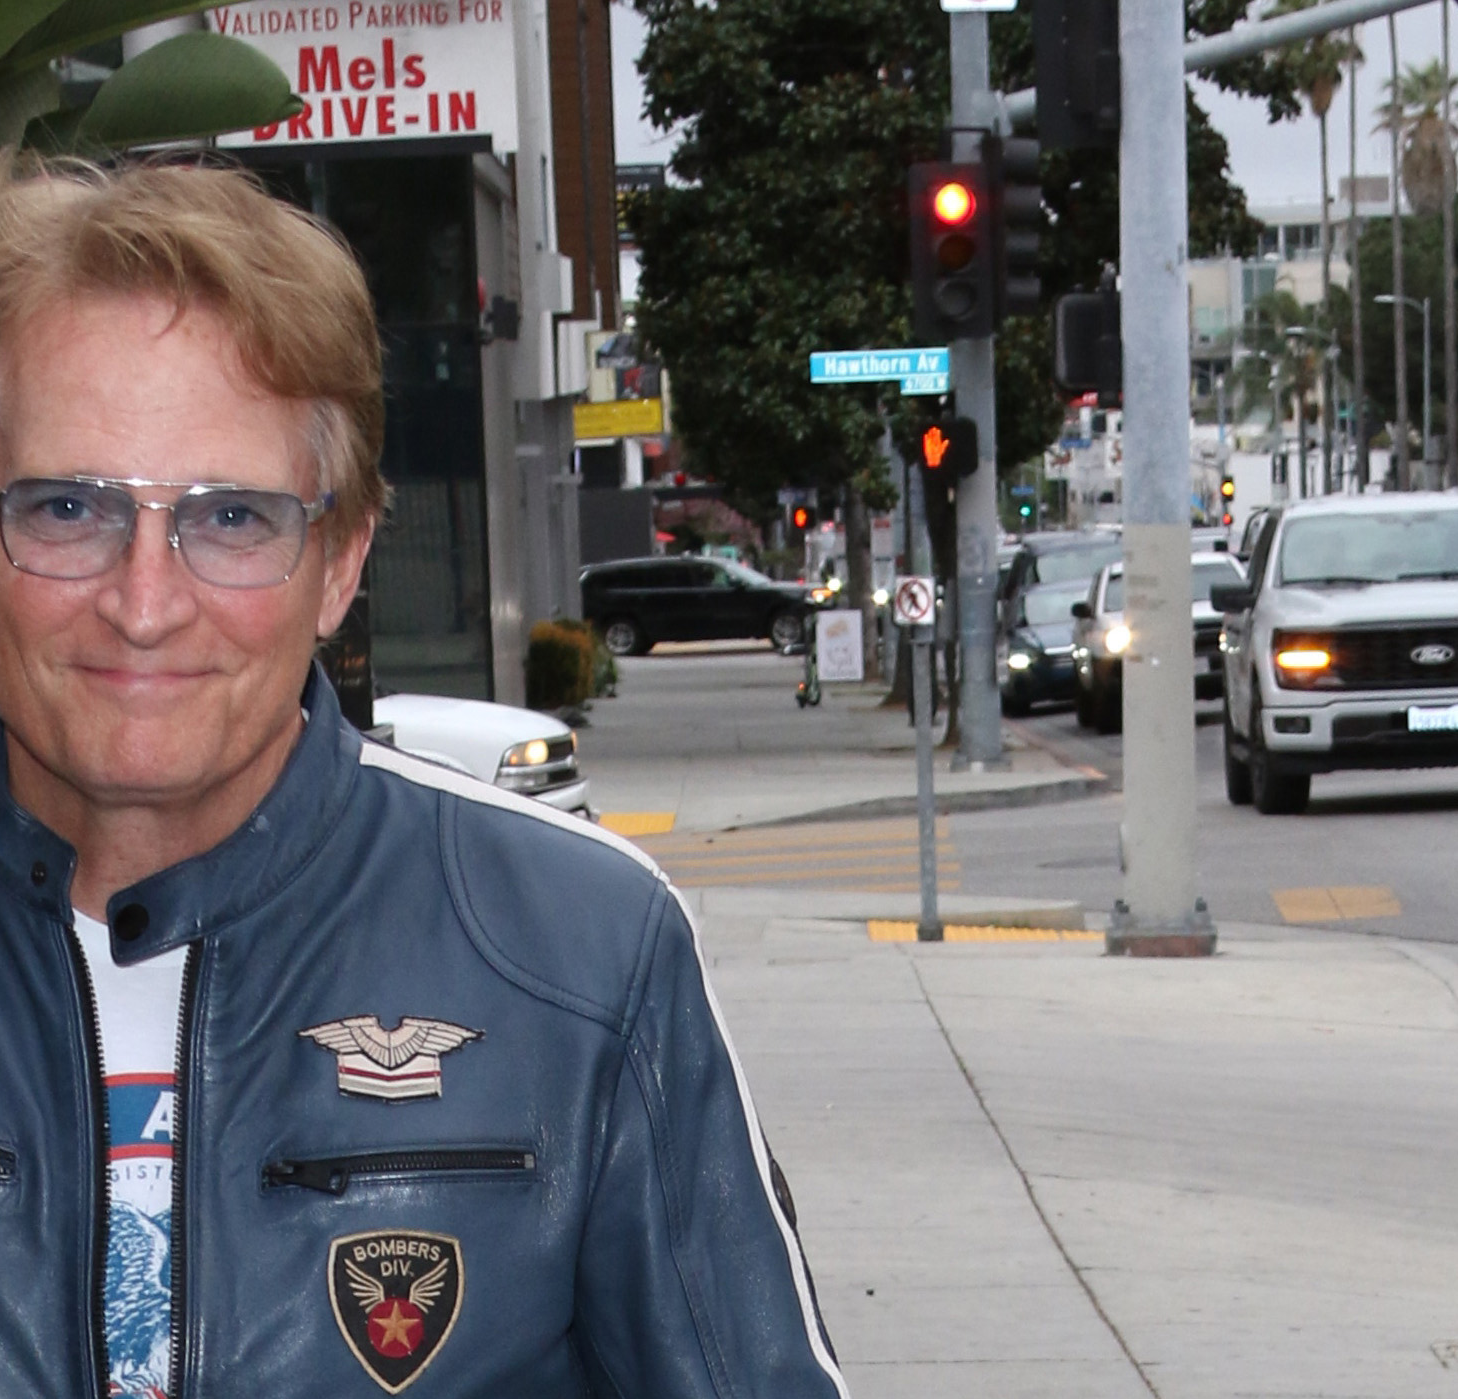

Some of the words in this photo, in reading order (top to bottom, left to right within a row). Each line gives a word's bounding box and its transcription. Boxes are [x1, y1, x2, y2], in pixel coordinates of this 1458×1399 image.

[214, 5, 339, 35] VALIDATED
[348, 1, 449, 29] PARKING
[458, 0, 503, 23] FOR
[298, 38, 427, 93] Mels
[824, 355, 911, 375] Hawthorn
[916, 352, 939, 371] Av
[353, 1239, 441, 1262] BOMBERS
[380, 1258, 415, 1278] DIV.
